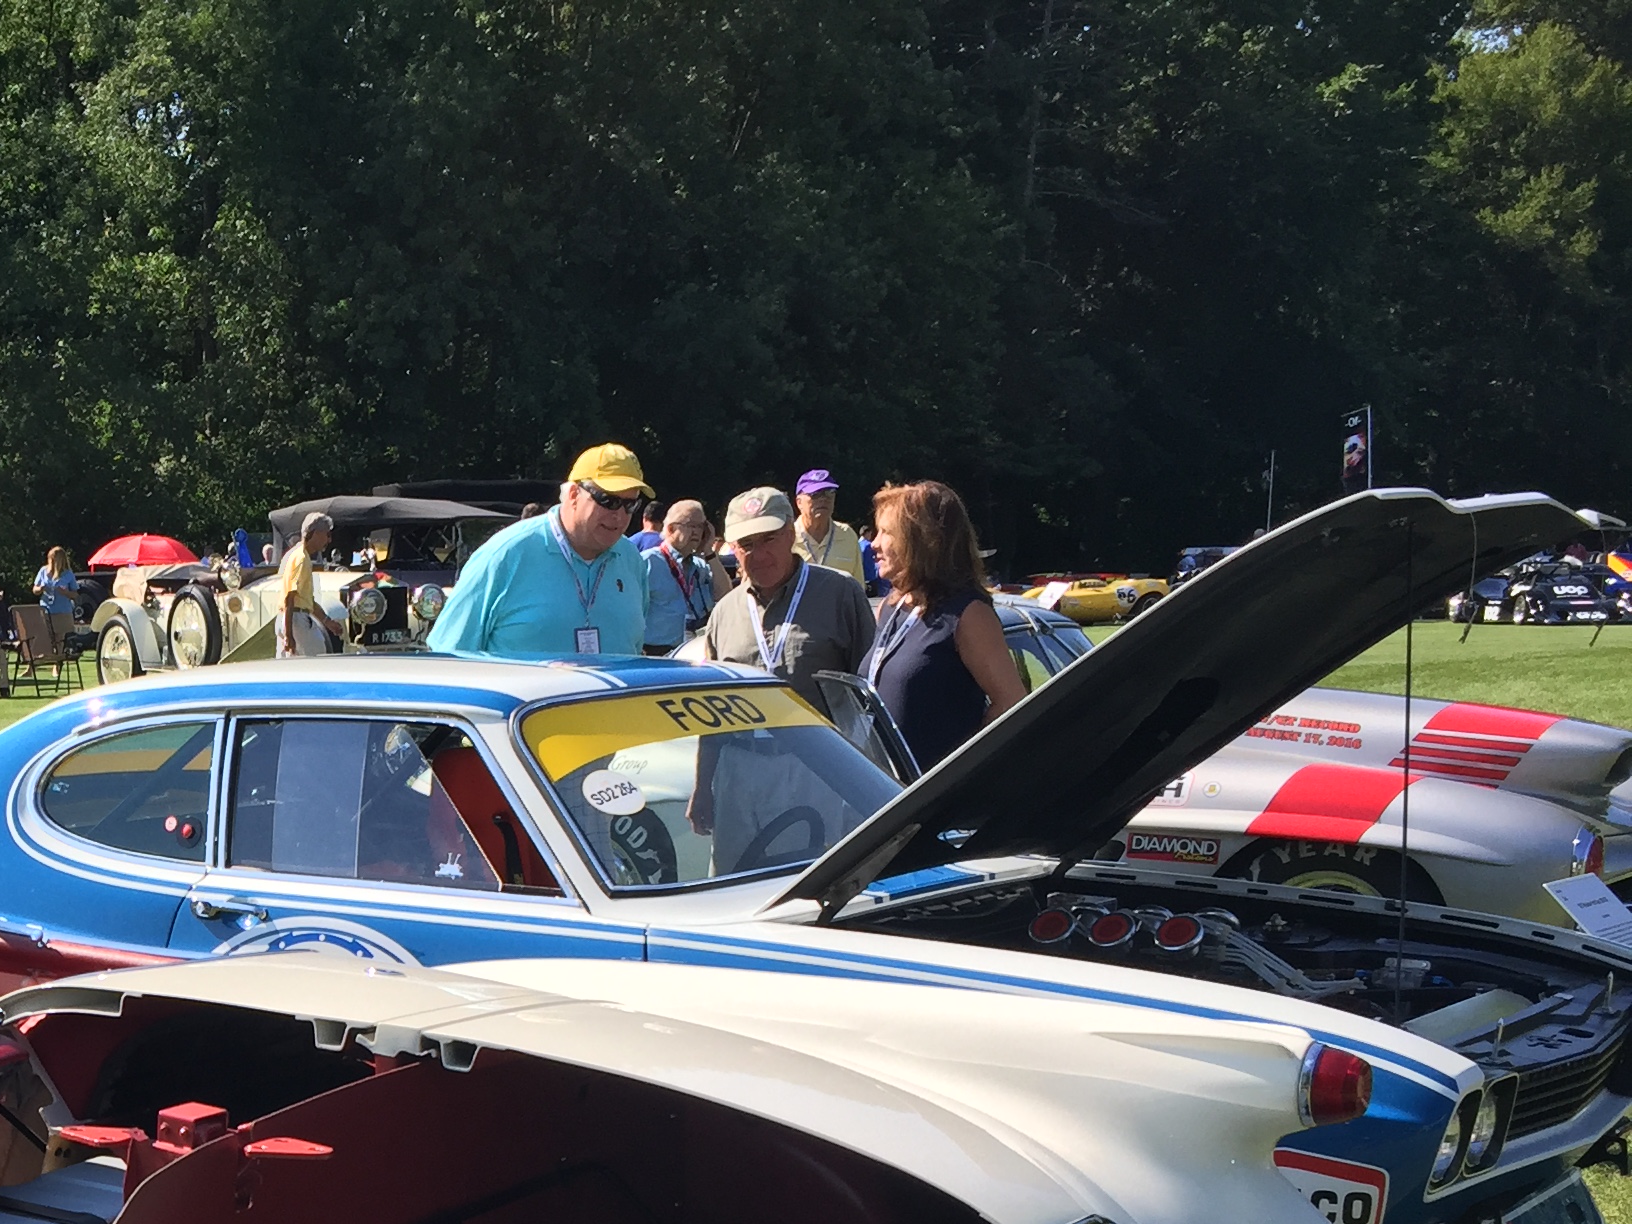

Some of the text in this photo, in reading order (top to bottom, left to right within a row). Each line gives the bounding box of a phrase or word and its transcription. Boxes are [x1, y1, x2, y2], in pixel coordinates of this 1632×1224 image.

[656, 694, 767, 732] FORD
[1298, 717, 1361, 733] RECORD
[1326, 735, 1362, 749] 2016
[611, 755, 648, 775] Group
[1131, 835, 1218, 856] DIAMOND
